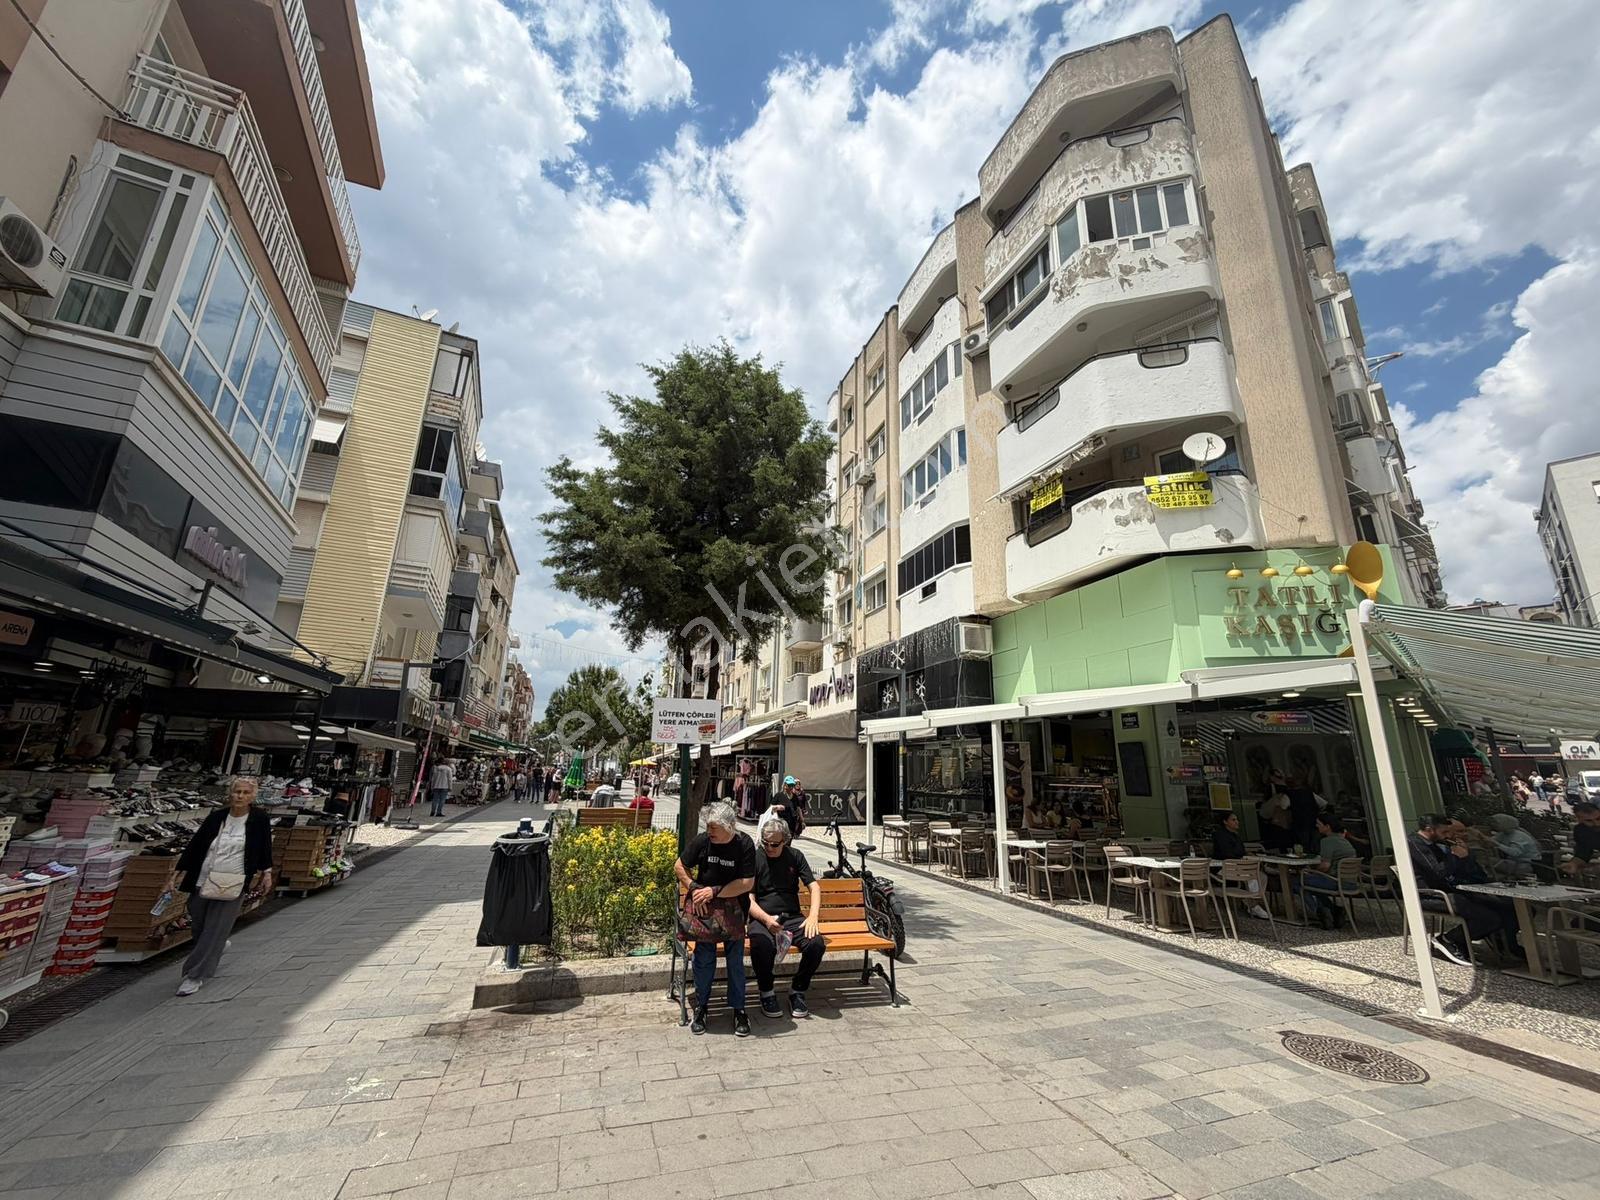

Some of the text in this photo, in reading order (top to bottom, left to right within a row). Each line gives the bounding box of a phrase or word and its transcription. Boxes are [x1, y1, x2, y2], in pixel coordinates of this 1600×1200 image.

[1227, 584, 1343, 607] TATLI
[1223, 608, 1350, 640] KAŞIĞ
[658, 710, 716, 719] LÜTFEN ÇÖPLERİ
[707, 855, 720, 863] KEEP
